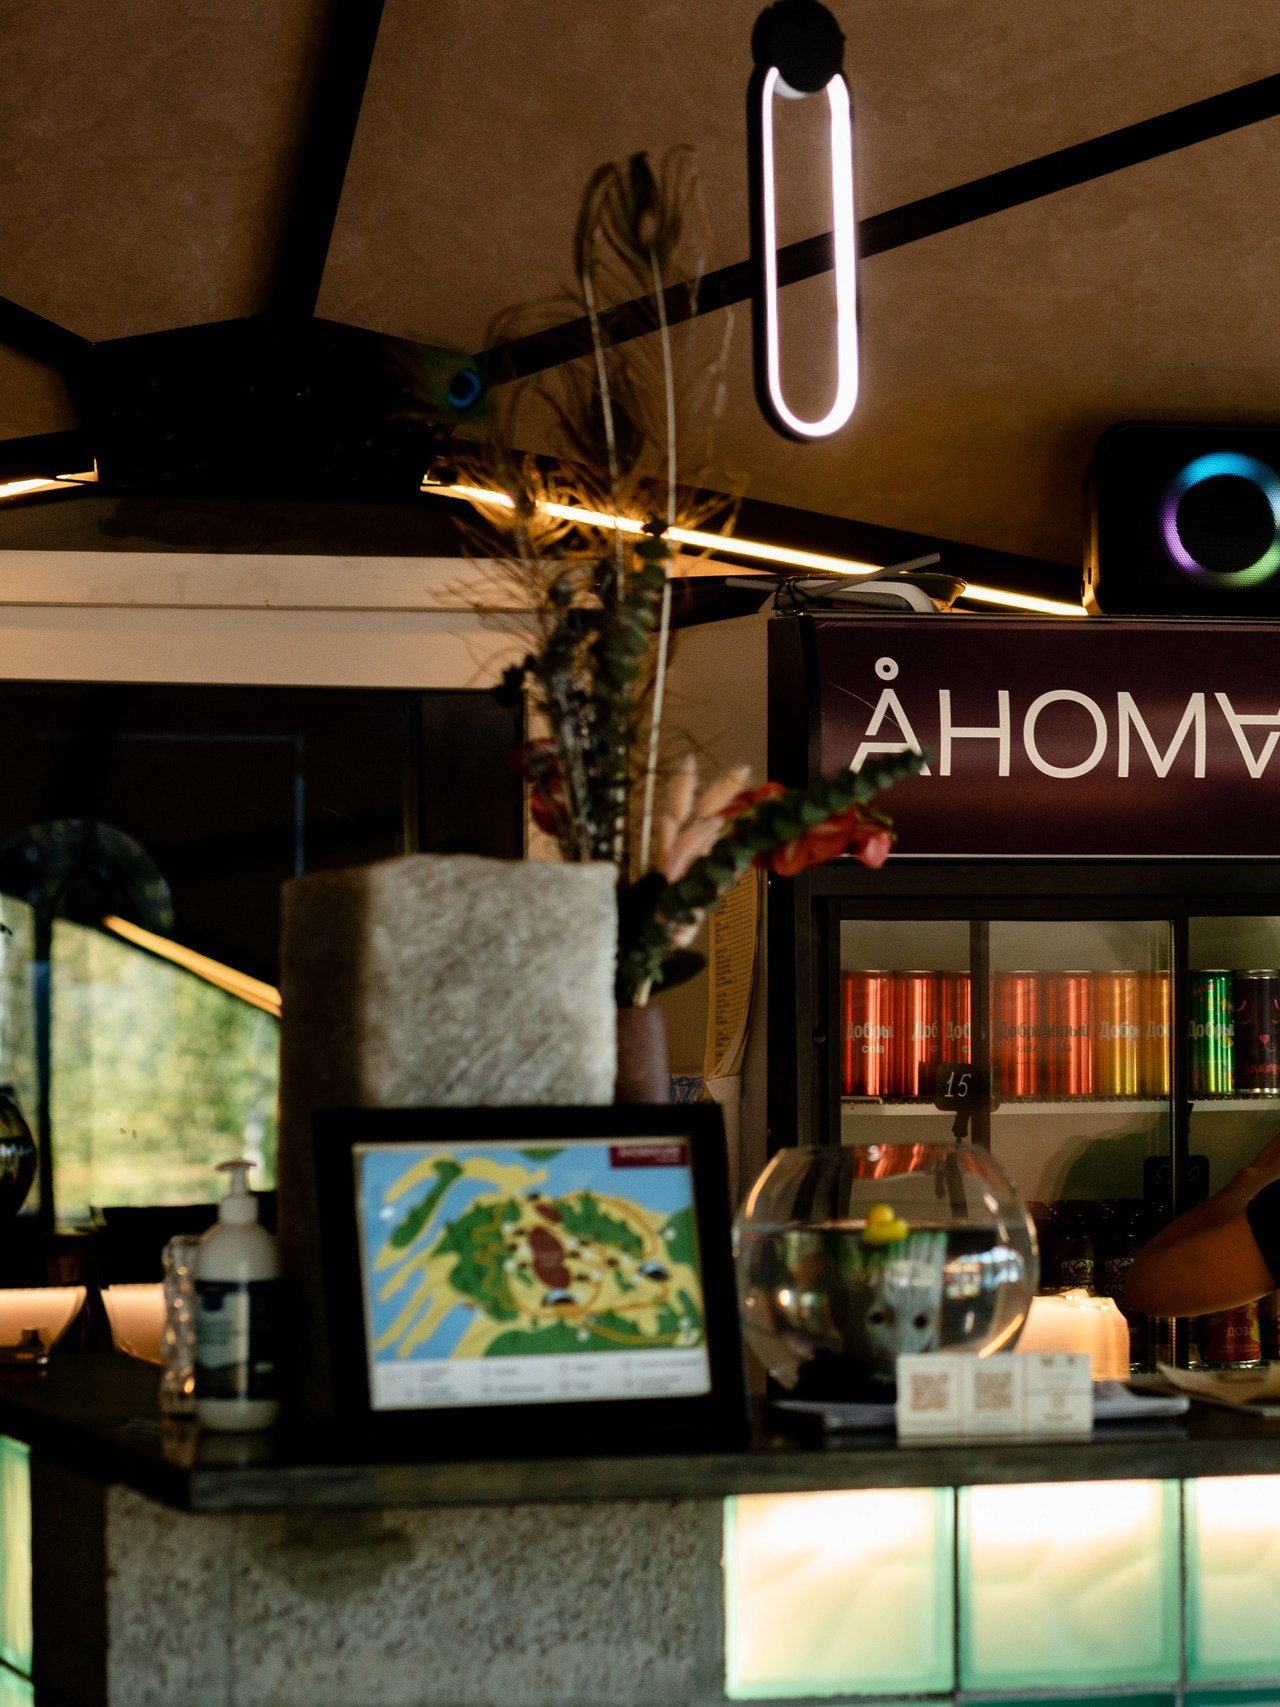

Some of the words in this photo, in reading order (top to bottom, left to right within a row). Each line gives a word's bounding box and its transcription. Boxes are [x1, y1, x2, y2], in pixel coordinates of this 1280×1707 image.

[911, 1020, 938, 1041] Доб
[946, 1020, 972, 1041] Доб
[944, 1071, 972, 1098] 15
